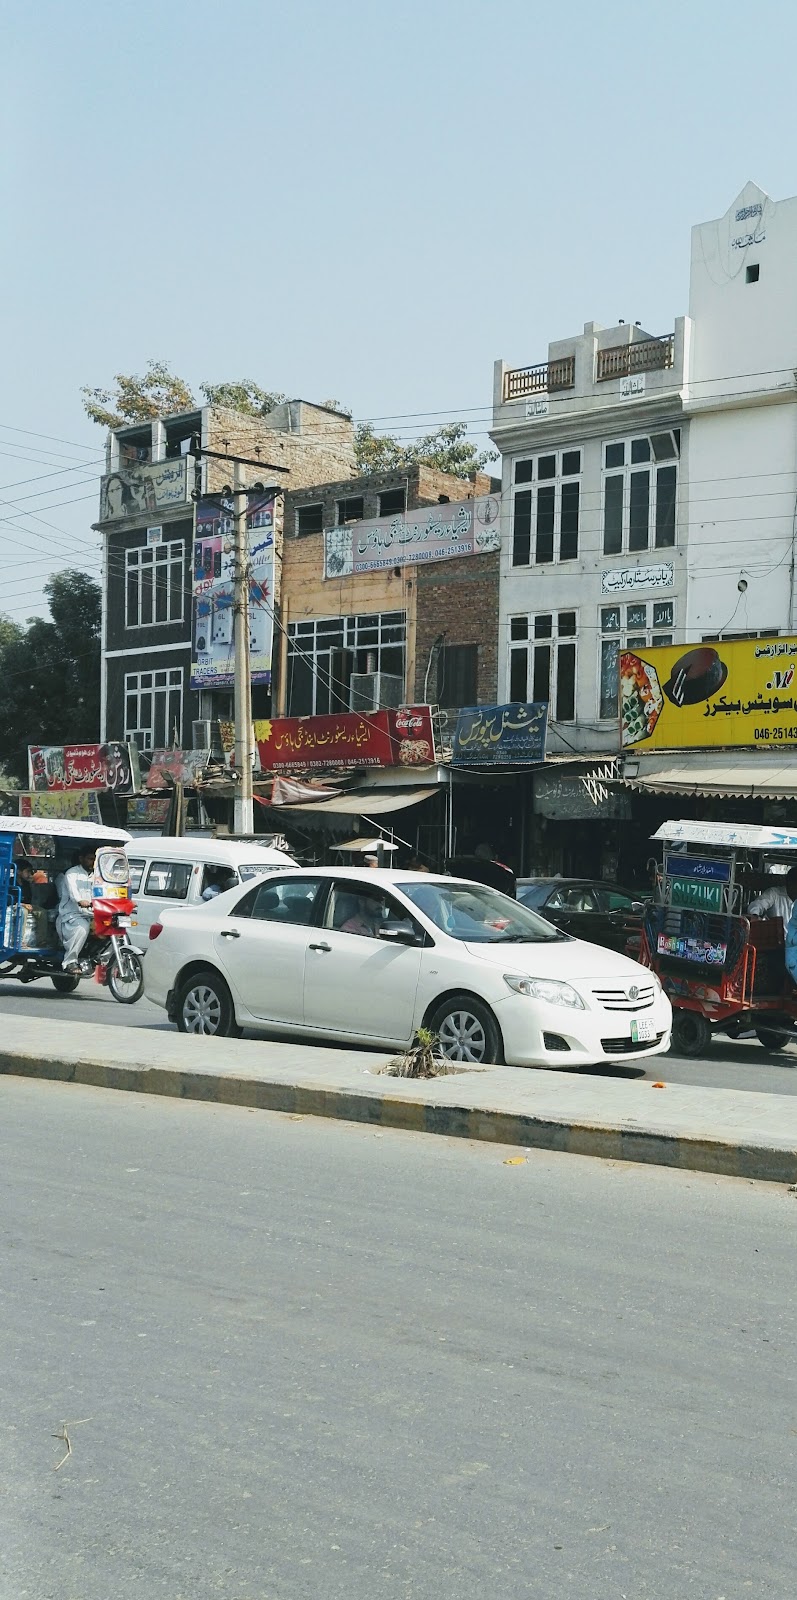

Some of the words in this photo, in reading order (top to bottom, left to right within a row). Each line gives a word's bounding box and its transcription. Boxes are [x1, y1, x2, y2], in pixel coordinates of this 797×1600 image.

[197, 657, 213, 666] ORBIT
[193, 667, 218, 675] TRADERS
[703, 696, 741, 717] بیکرز
[742, 693, 793, 715] سویٹس
[105, 746, 130, 789] روشن
[660, 936, 687, 951] Roshani
